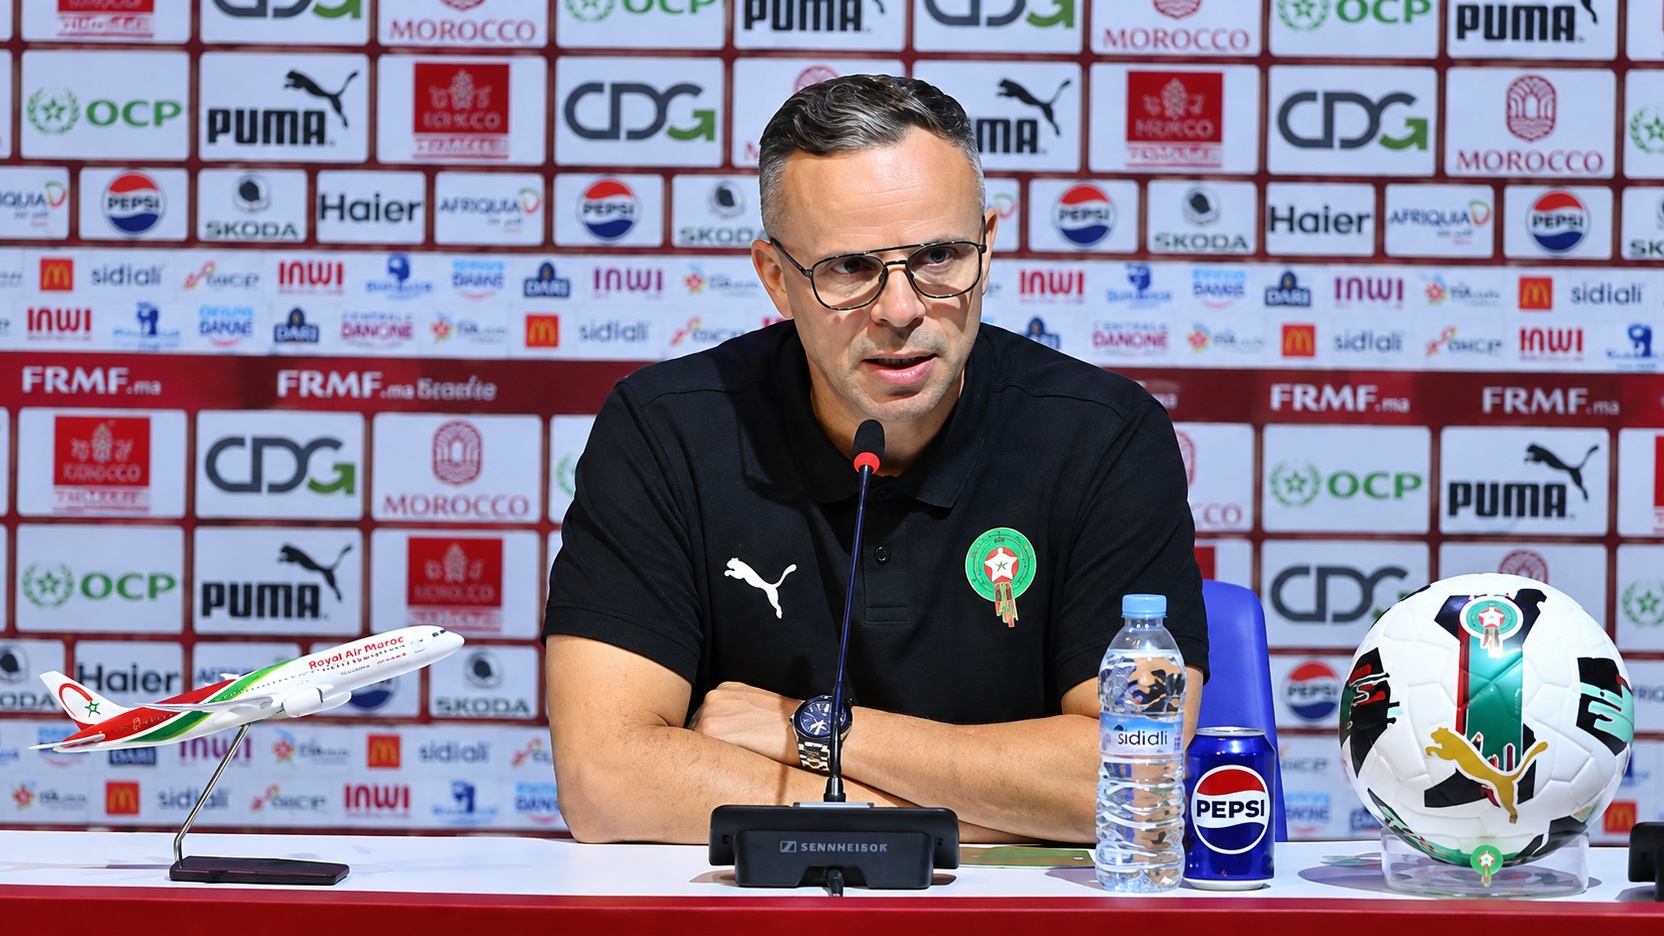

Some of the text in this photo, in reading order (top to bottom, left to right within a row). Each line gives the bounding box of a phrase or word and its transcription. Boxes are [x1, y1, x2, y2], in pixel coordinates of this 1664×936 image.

[743, 0, 862, 31] PUMA
[1336, 0, 1431, 23] OCP
[1455, 5, 1575, 42] PUMA
[389, 19, 537, 42] MOROCCO
[1103, 28, 1250, 50] MOROCCO
[86, 100, 182, 127] OCP
[564, 82, 716, 142] CDG
[1277, 91, 1428, 151] CDG
[207, 109, 326, 145] PUMA
[976, 119, 1038, 154] MA
[1456, 150, 1604, 174] MOROCCO
[107, 196, 161, 210] PEPSI
[318, 193, 422, 222] Haier
[1268, 206, 1373, 235] Haier
[1388, 210, 1470, 227] AFRIQUIA
[1531, 214, 1584, 229] PEPSI
[205, 436, 355, 495] CDG
[1327, 471, 1423, 499] OCP
[383, 494, 529, 518] MOROCCO
[1448, 482, 1567, 518] PUMA
[80, 572, 176, 600] OCP
[202, 582, 320, 619] PUMA
[308, 653, 342, 670] Royal
[345, 647, 362, 660] Air
[364, 636, 404, 654] Maroc
[78, 663, 178, 693] Haier
[1196, 799, 1265, 819] PEPSI
